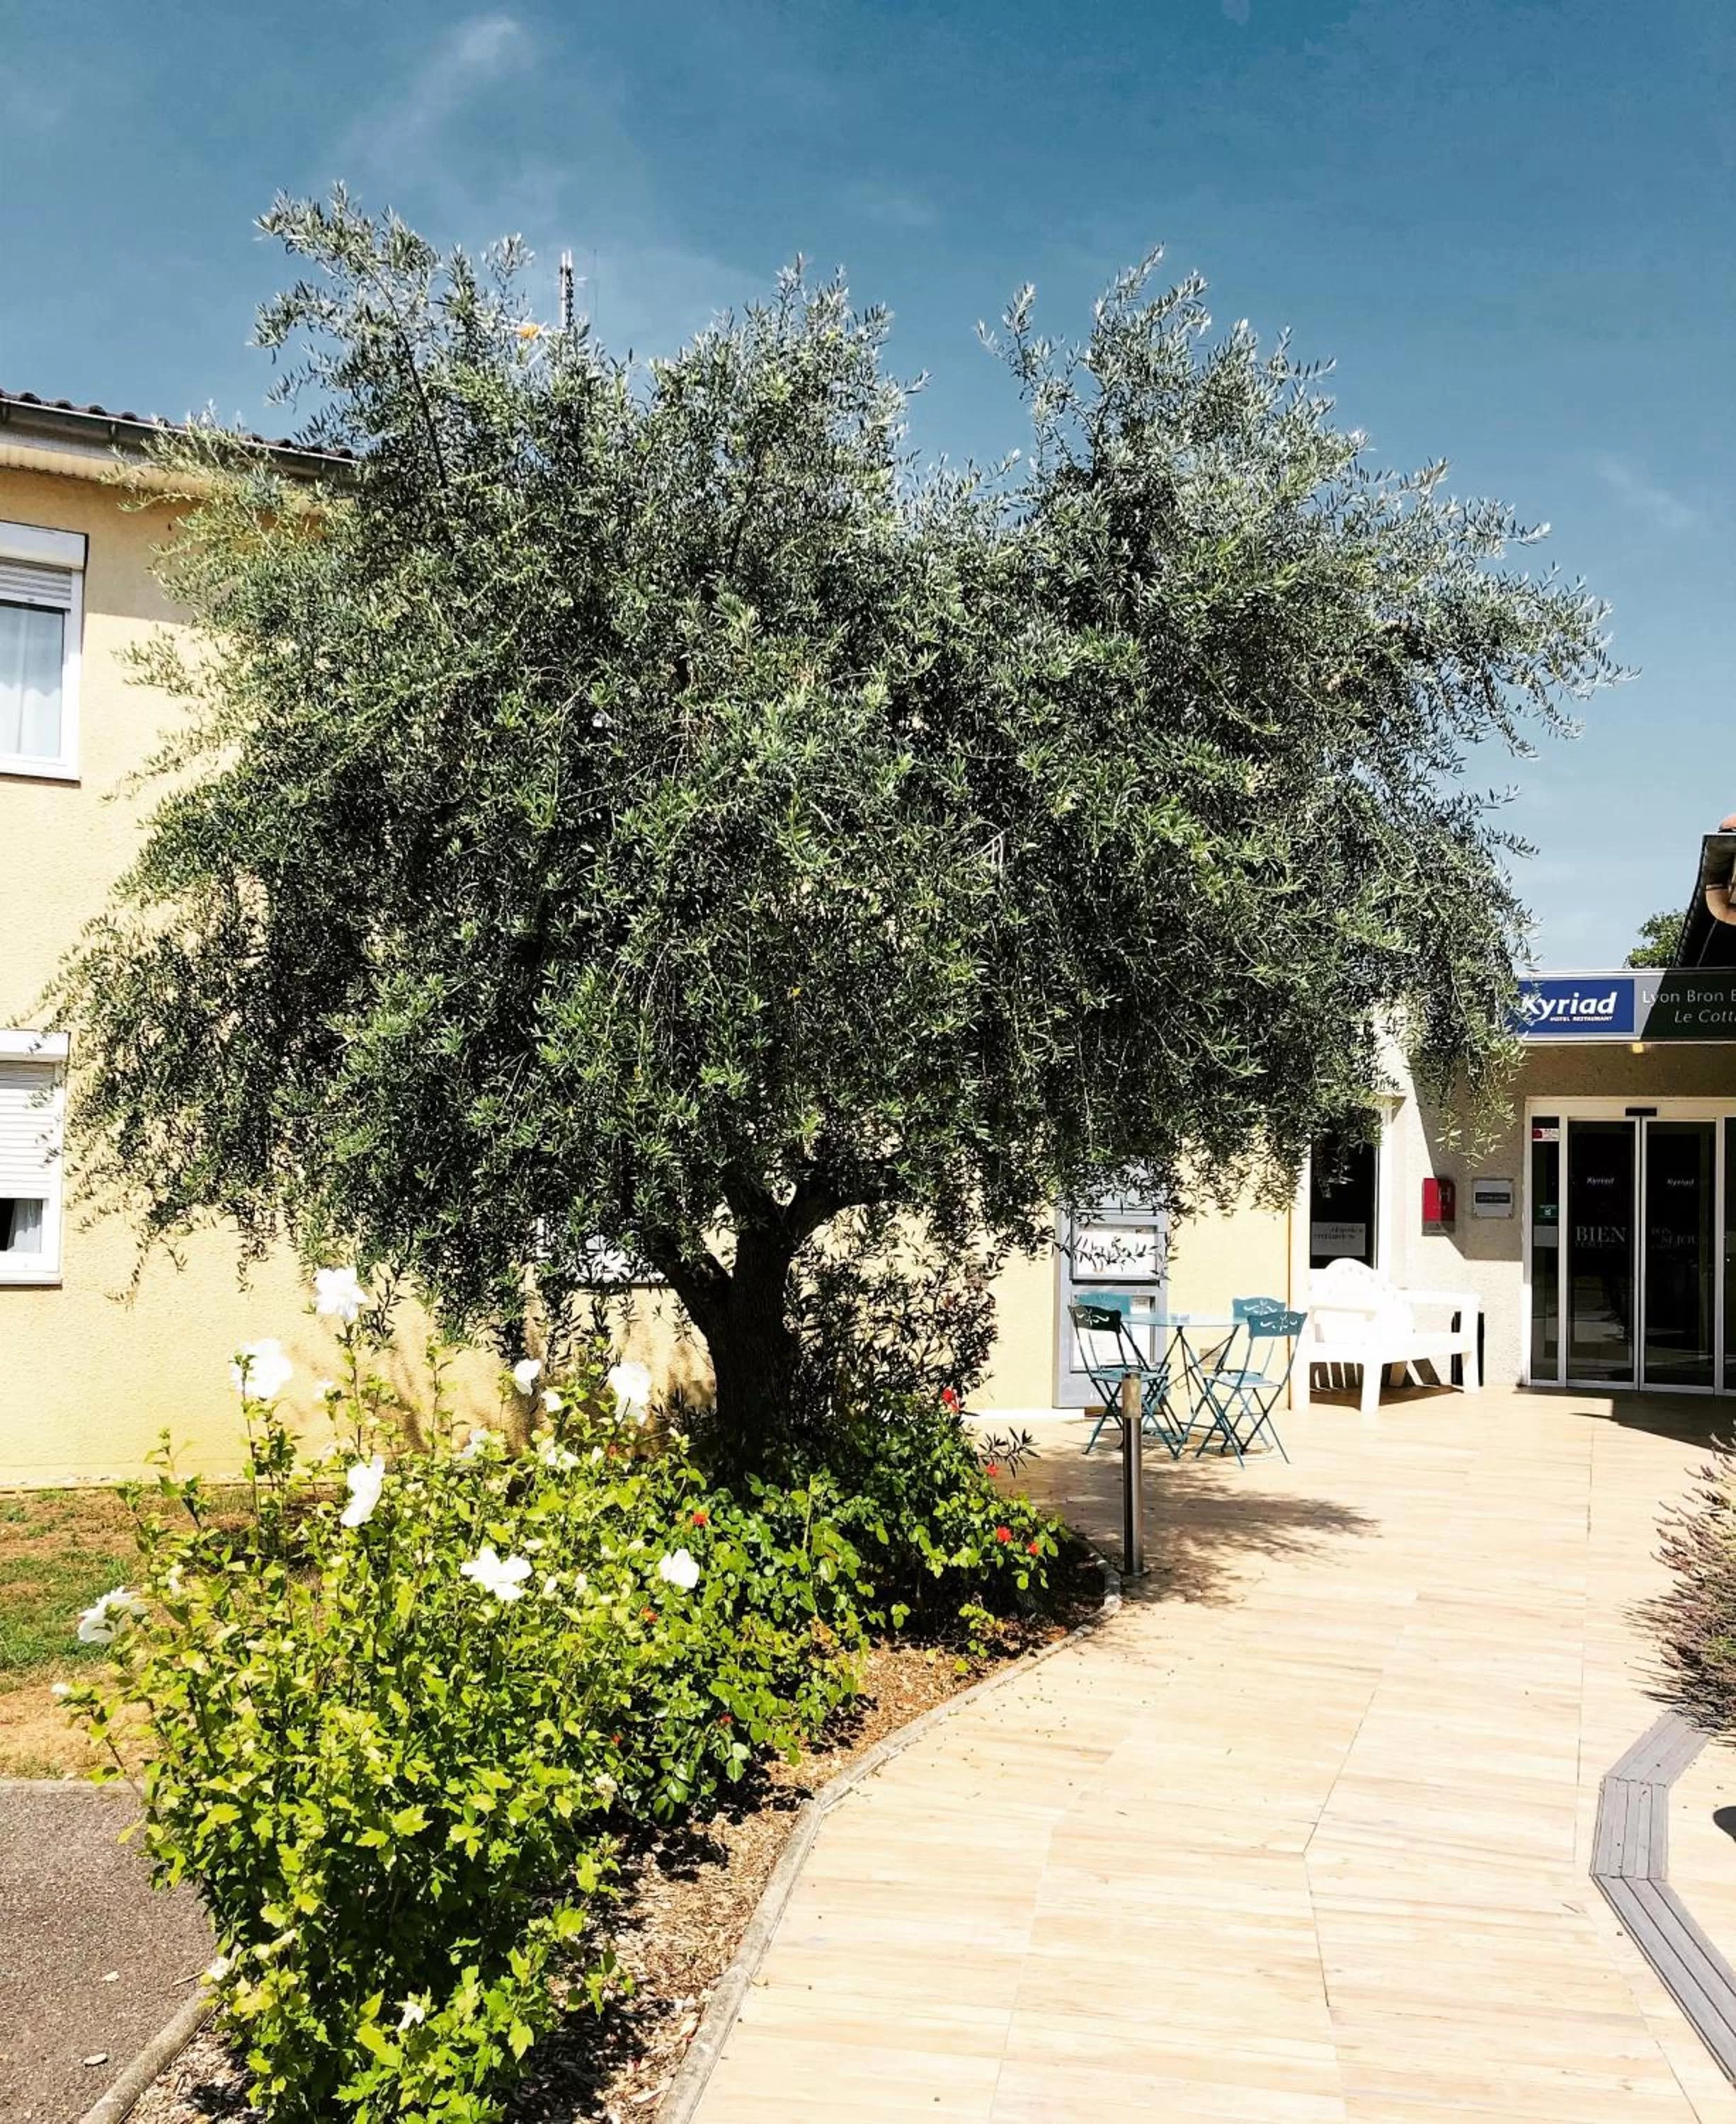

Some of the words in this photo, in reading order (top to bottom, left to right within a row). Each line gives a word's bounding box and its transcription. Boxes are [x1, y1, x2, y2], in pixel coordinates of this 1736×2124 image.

[1642, 990, 1680, 1006] Lyon
[1687, 989, 1724, 1003] Bron
[1521, 992, 1617, 1024] Kyriad
[1674, 1010, 1693, 1023] Le
[1699, 1009, 1736, 1023] Cott
[1575, 1226, 1626, 1242] BIEN
